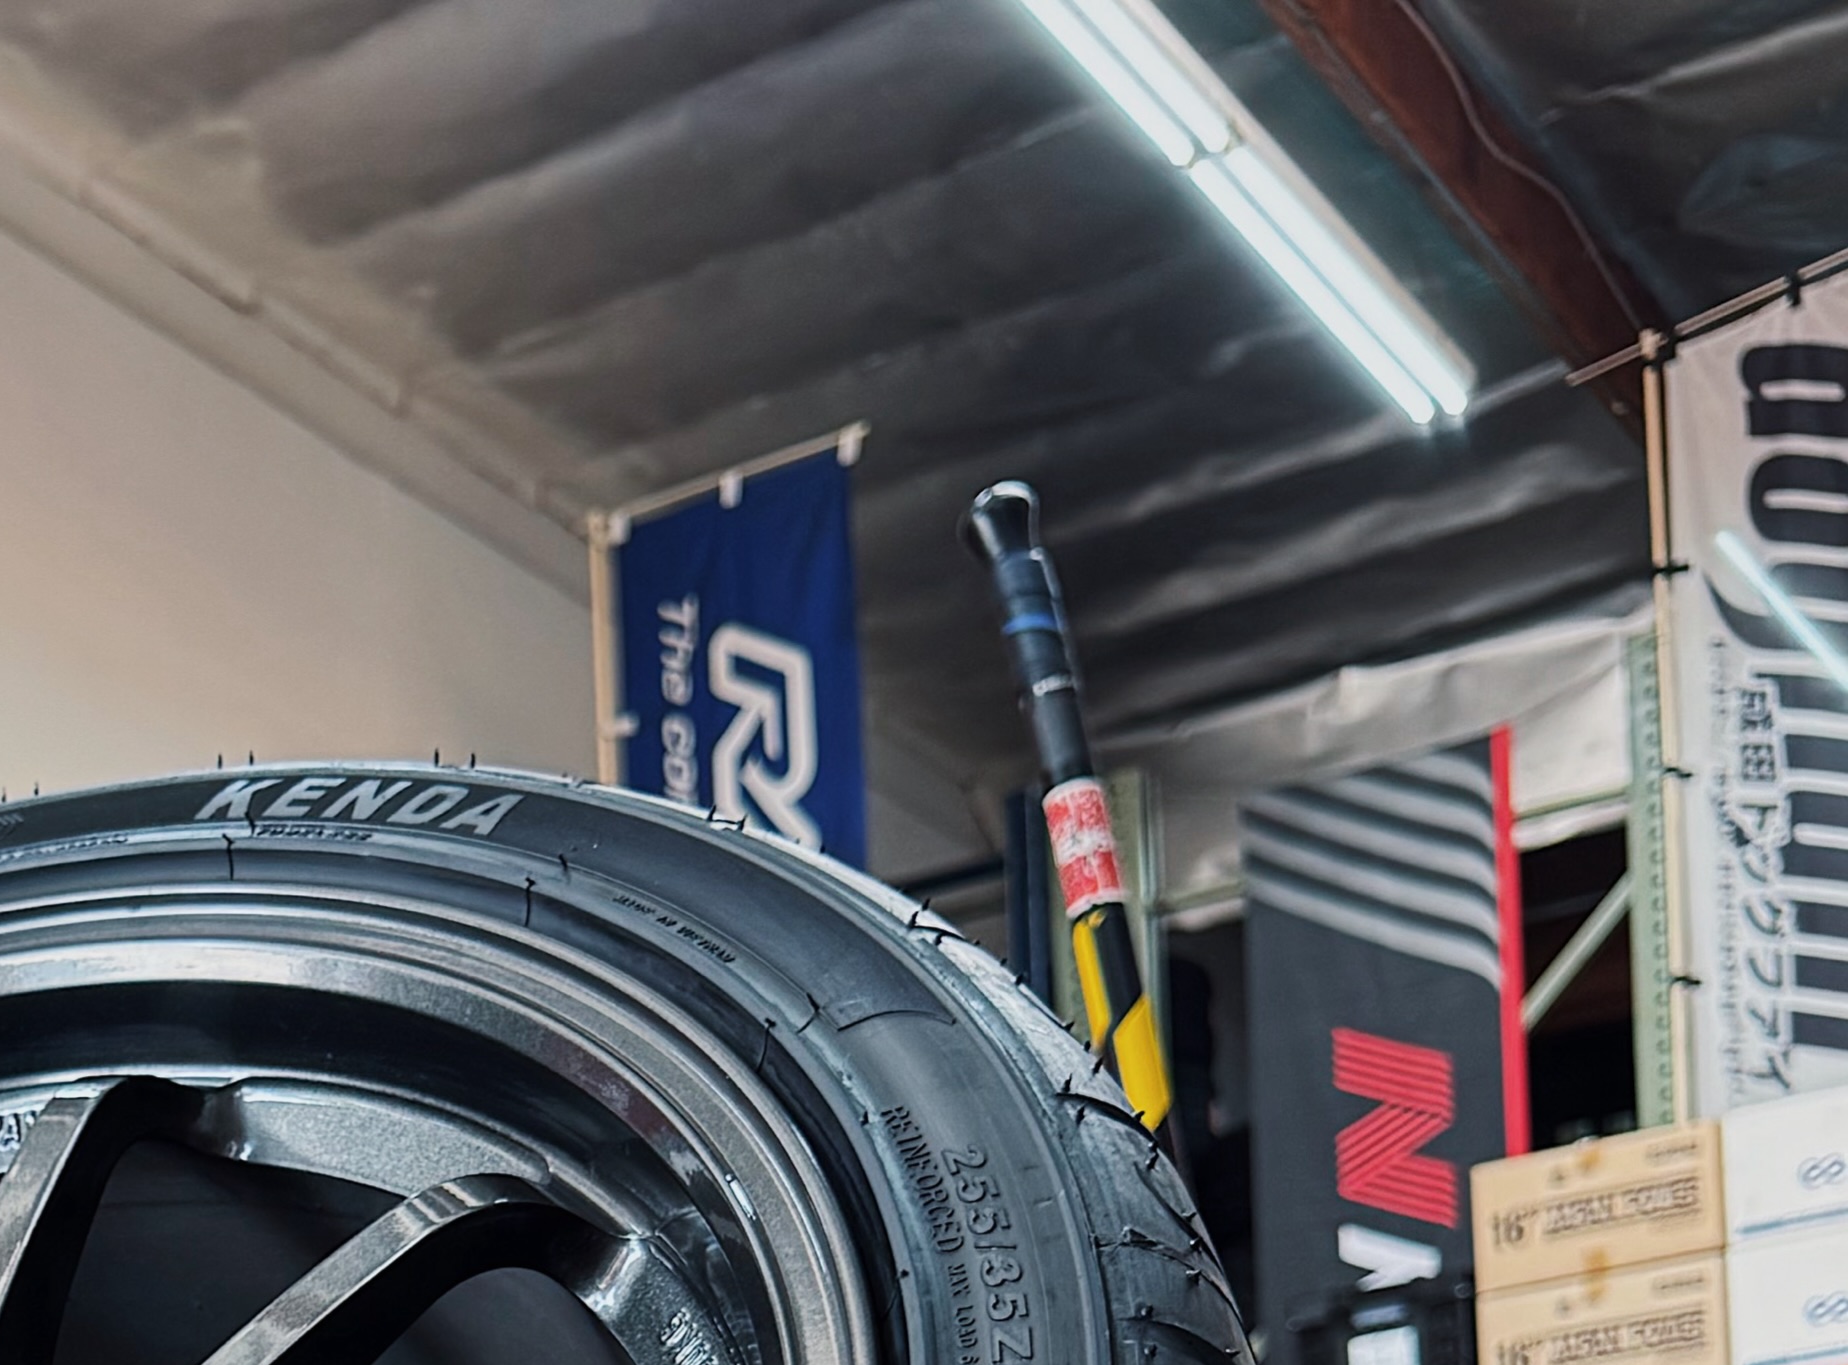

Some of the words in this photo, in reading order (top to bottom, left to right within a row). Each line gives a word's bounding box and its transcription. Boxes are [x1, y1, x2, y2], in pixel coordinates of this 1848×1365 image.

[657, 593, 699, 707] The
[194, 778, 524, 836] KENDA
[879, 1104, 965, 1254] REINFORCED
[954, 1305, 977, 1348] LOAD
